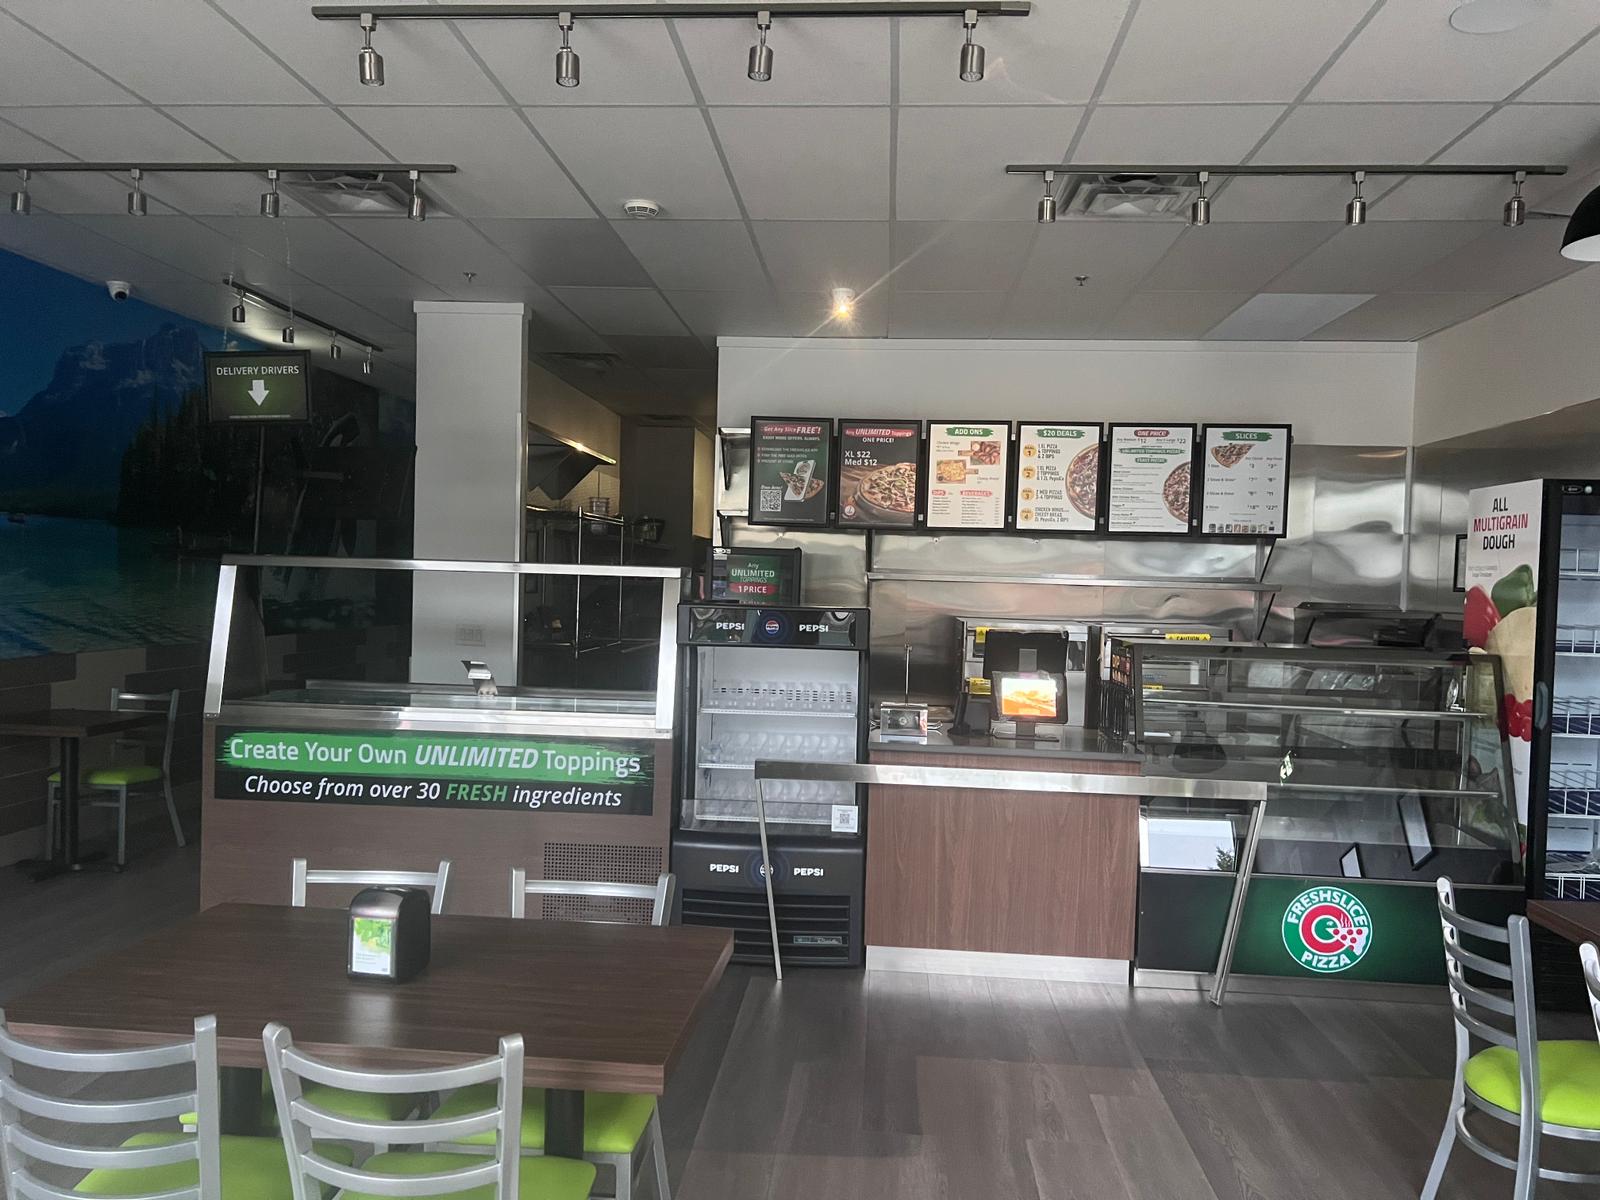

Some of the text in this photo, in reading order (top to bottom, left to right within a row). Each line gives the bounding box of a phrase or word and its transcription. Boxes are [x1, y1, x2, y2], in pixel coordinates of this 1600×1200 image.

[216, 365, 300, 376] DELIVERY DRIVERS
[1492, 497, 1508, 512] ALL
[1474, 514, 1528, 532] MULTIGRAIN
[1483, 534, 1515, 550] DOUGH
[731, 569, 774, 578] UNLIMITED
[716, 622, 744, 630] PEPSI
[799, 624, 828, 632] PEPSI
[230, 738, 641, 778] Create Your Own UNLIMITED Toppings
[245, 775, 622, 808] Choose from over 30 FRESH ingredients
[710, 864, 824, 876] PEPSI PEPSI
[1287, 890, 1368, 926] FRESHSLICE
[1300, 950, 1351, 968] PIZZA
